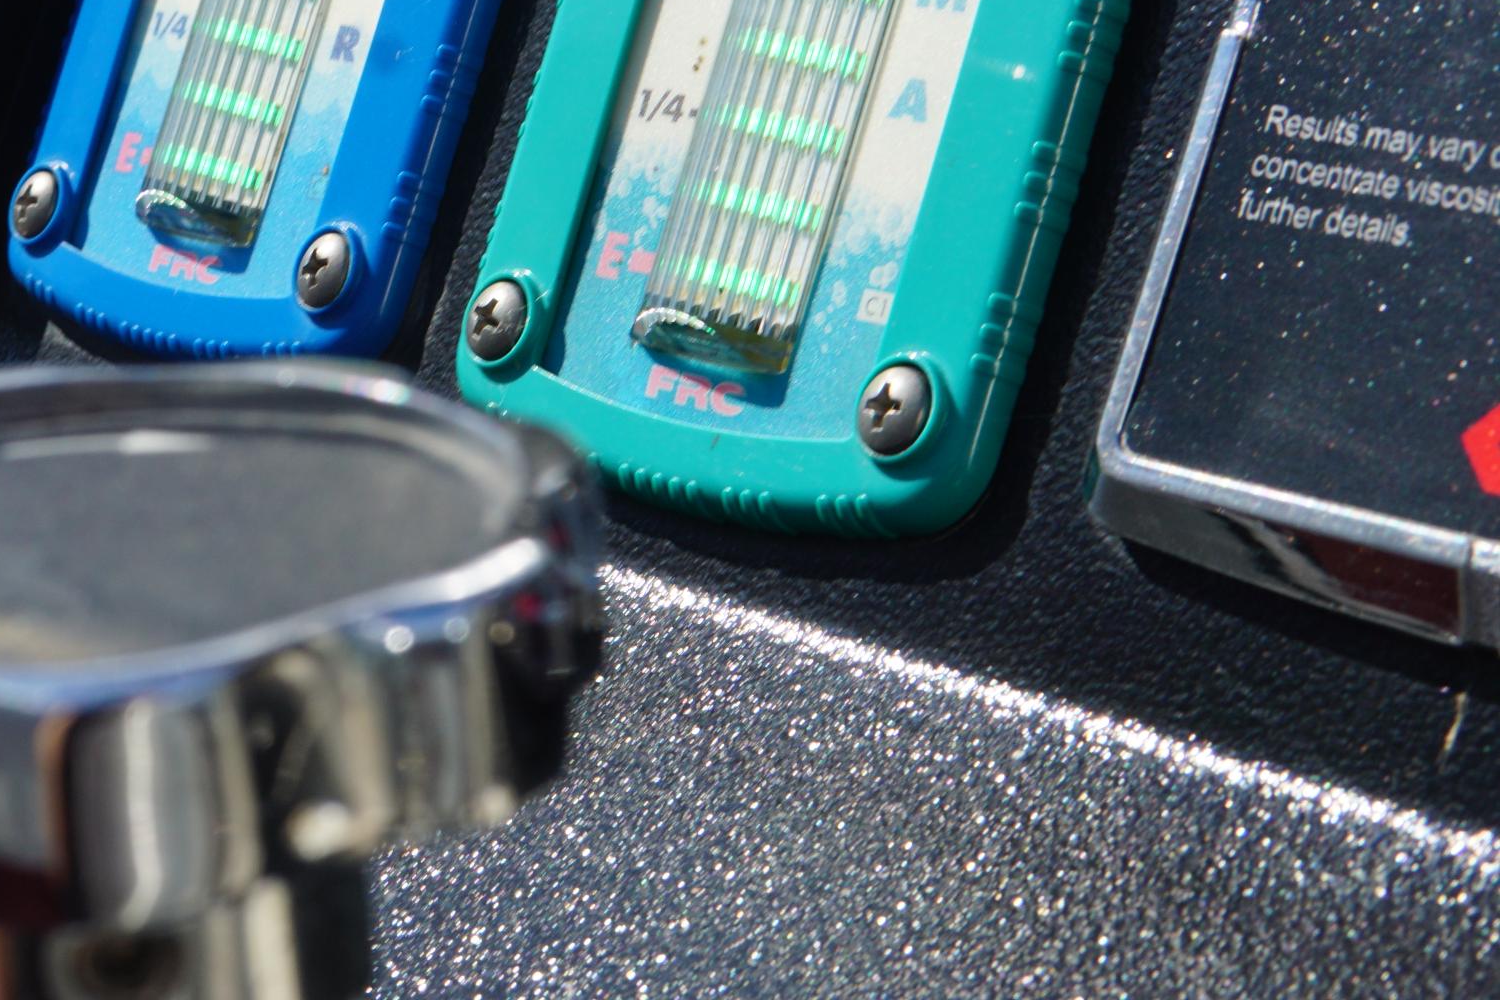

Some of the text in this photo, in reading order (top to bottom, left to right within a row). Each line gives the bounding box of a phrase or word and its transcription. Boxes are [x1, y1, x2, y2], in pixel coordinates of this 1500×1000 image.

[151, 10, 190, 40] 1/4
[636, 88, 687, 123] 1/4
[114, 132, 142, 174] E
[1263, 103, 1360, 148] Results
[1363, 126, 1424, 163] may
[1428, 134, 1488, 174] vary
[1250, 153, 1401, 201] concentrate
[1237, 189, 1323, 230] further
[147, 243, 223, 285] FRC
[595, 231, 630, 280] E
[645, 365, 747, 417] FRC
